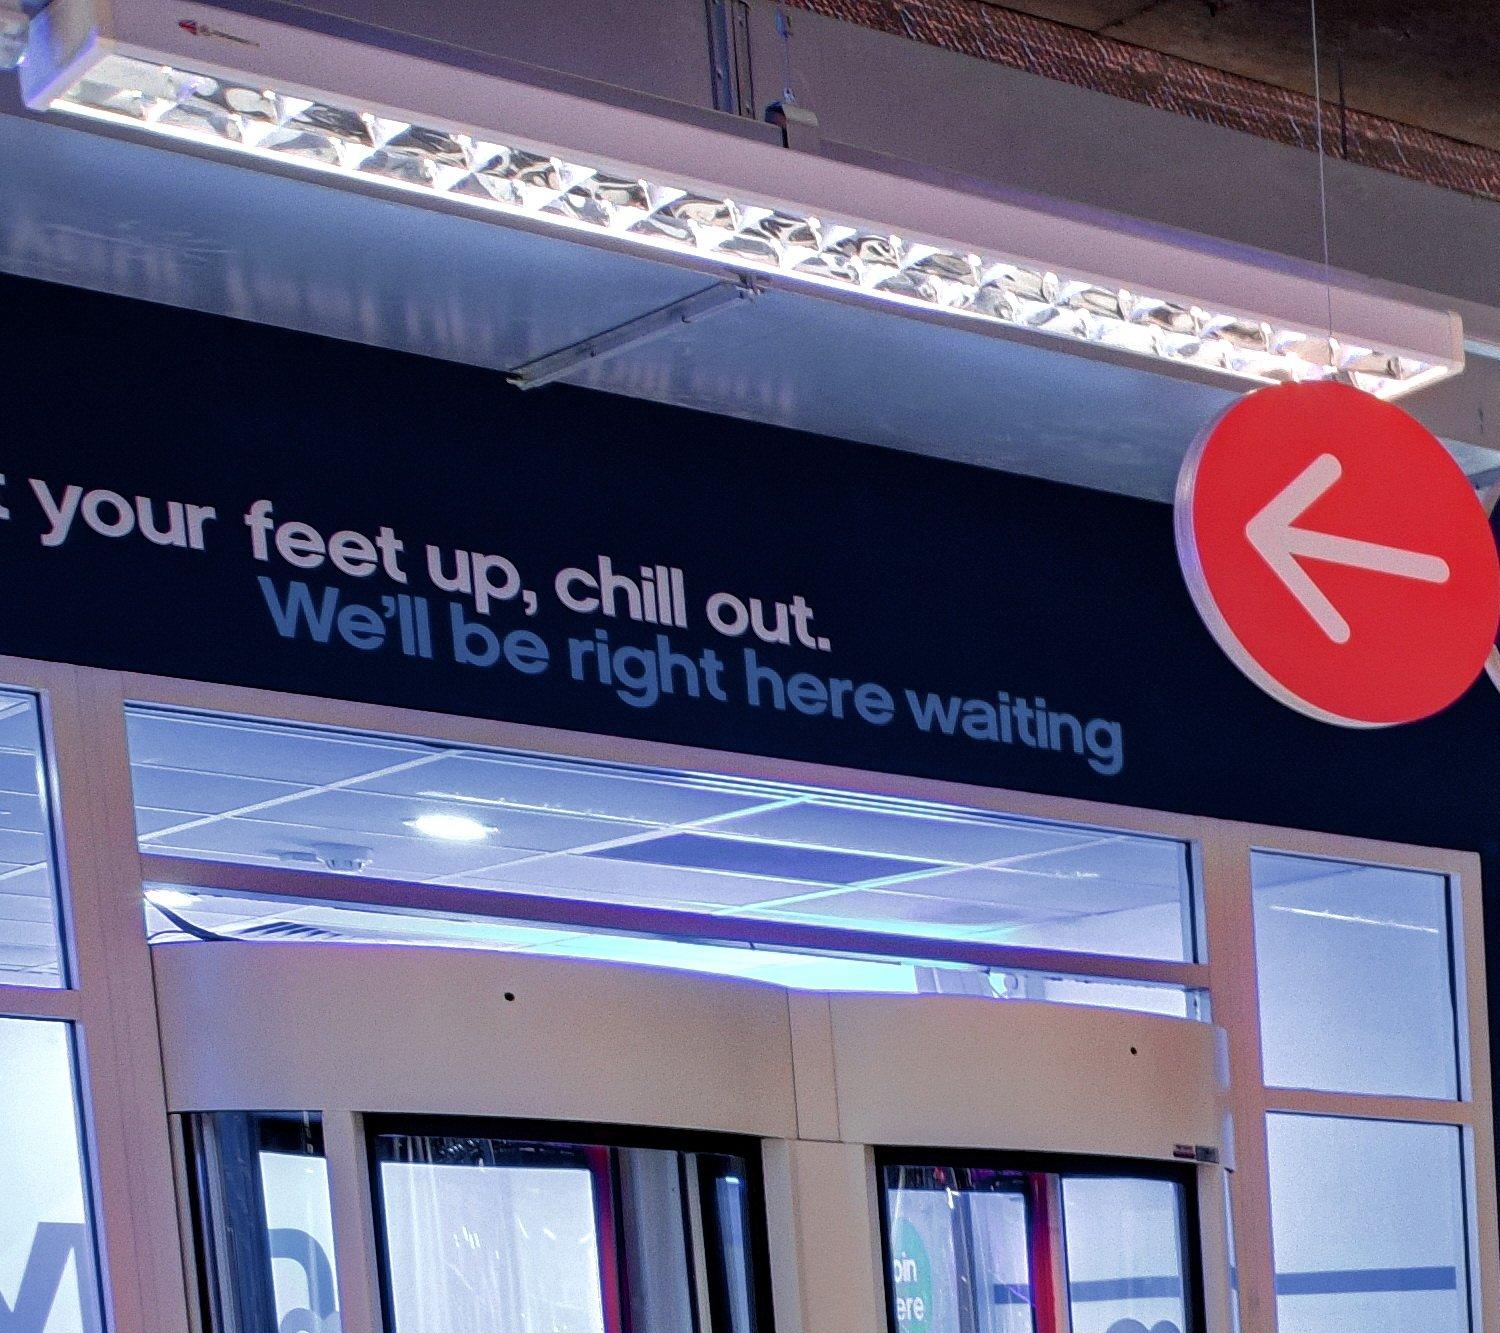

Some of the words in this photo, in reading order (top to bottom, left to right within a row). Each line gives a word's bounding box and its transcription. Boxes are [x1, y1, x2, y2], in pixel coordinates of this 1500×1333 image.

[28, 477, 216, 550] your
[244, 499, 407, 584] feet
[426, 543, 538, 616] up,
[554, 554, 688, 629] chill
[705, 591, 832, 653] out.
[256, 575, 434, 660] We'll
[449, 602, 550, 675] be
[568, 627, 727, 709] right
[743, 647, 897, 727] here
[904, 689, 1125, 777] waiting
[893, 1251, 918, 1284] oin
[896, 1295, 925, 1322] ere
